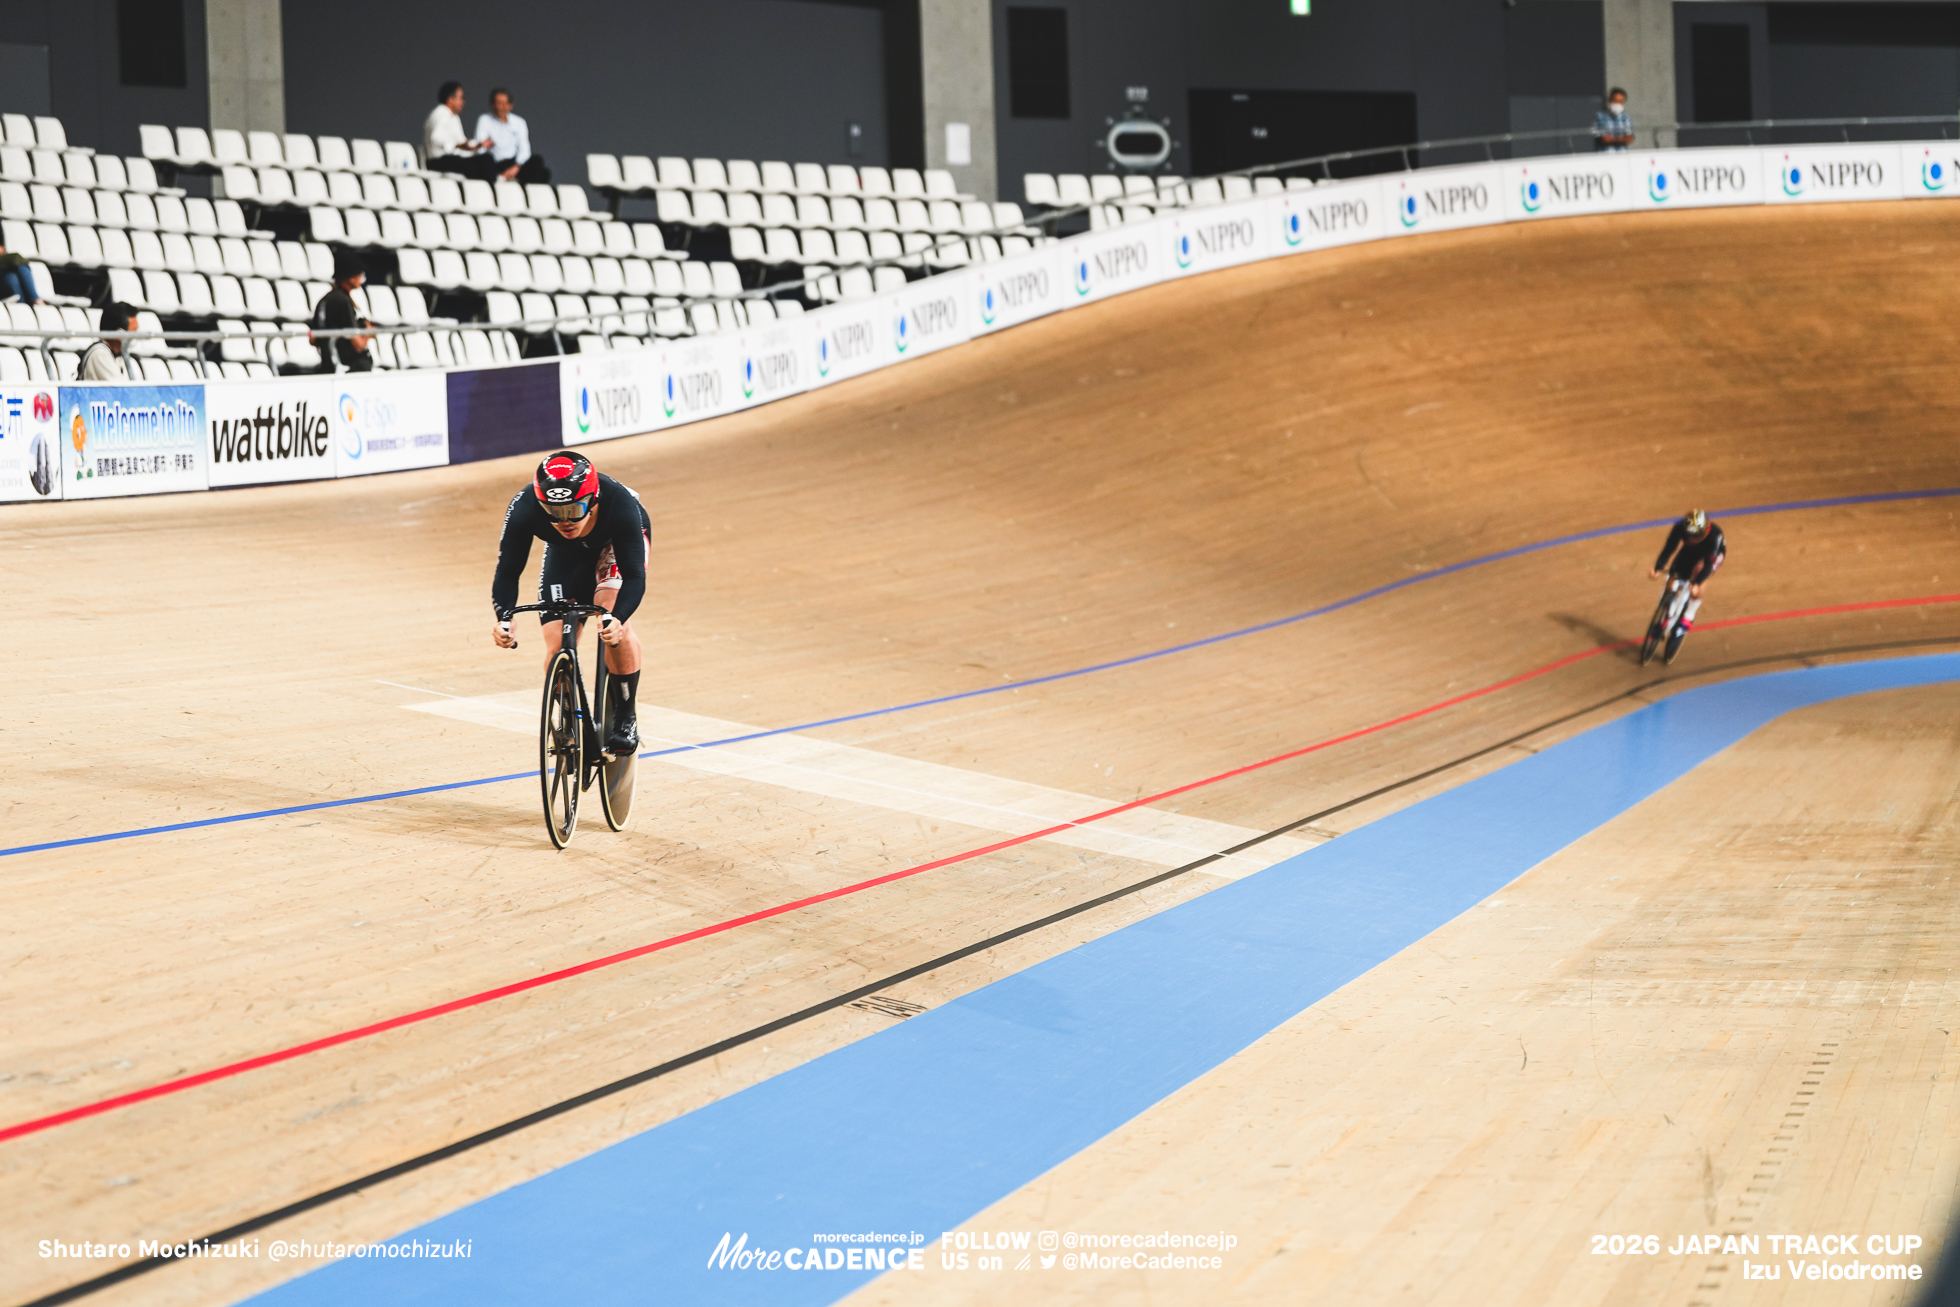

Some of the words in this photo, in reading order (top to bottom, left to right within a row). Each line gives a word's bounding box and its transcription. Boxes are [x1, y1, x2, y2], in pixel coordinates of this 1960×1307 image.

[1548, 173, 1614, 201] NIPPO
[1677, 166, 1745, 193] NIPPO
[1812, 161, 1883, 189] NIPPO
[1308, 199, 1368, 234] NIPPO
[1425, 184, 1488, 216] NIPPO
[1197, 219, 1254, 254] NIPPO
[1095, 241, 1147, 280] NIPPO
[999, 268, 1049, 308] NIPPO
[911, 296, 957, 340] NIPPO
[831, 321, 874, 364] NIPPO
[680, 370, 722, 414] NIPPO
[758, 350, 798, 394] NIPPO
[91, 402, 160, 449] Welcome
[160, 404, 175, 445] to
[595, 385, 641, 431] NIPPO
[212, 401, 329, 463] wattbike
